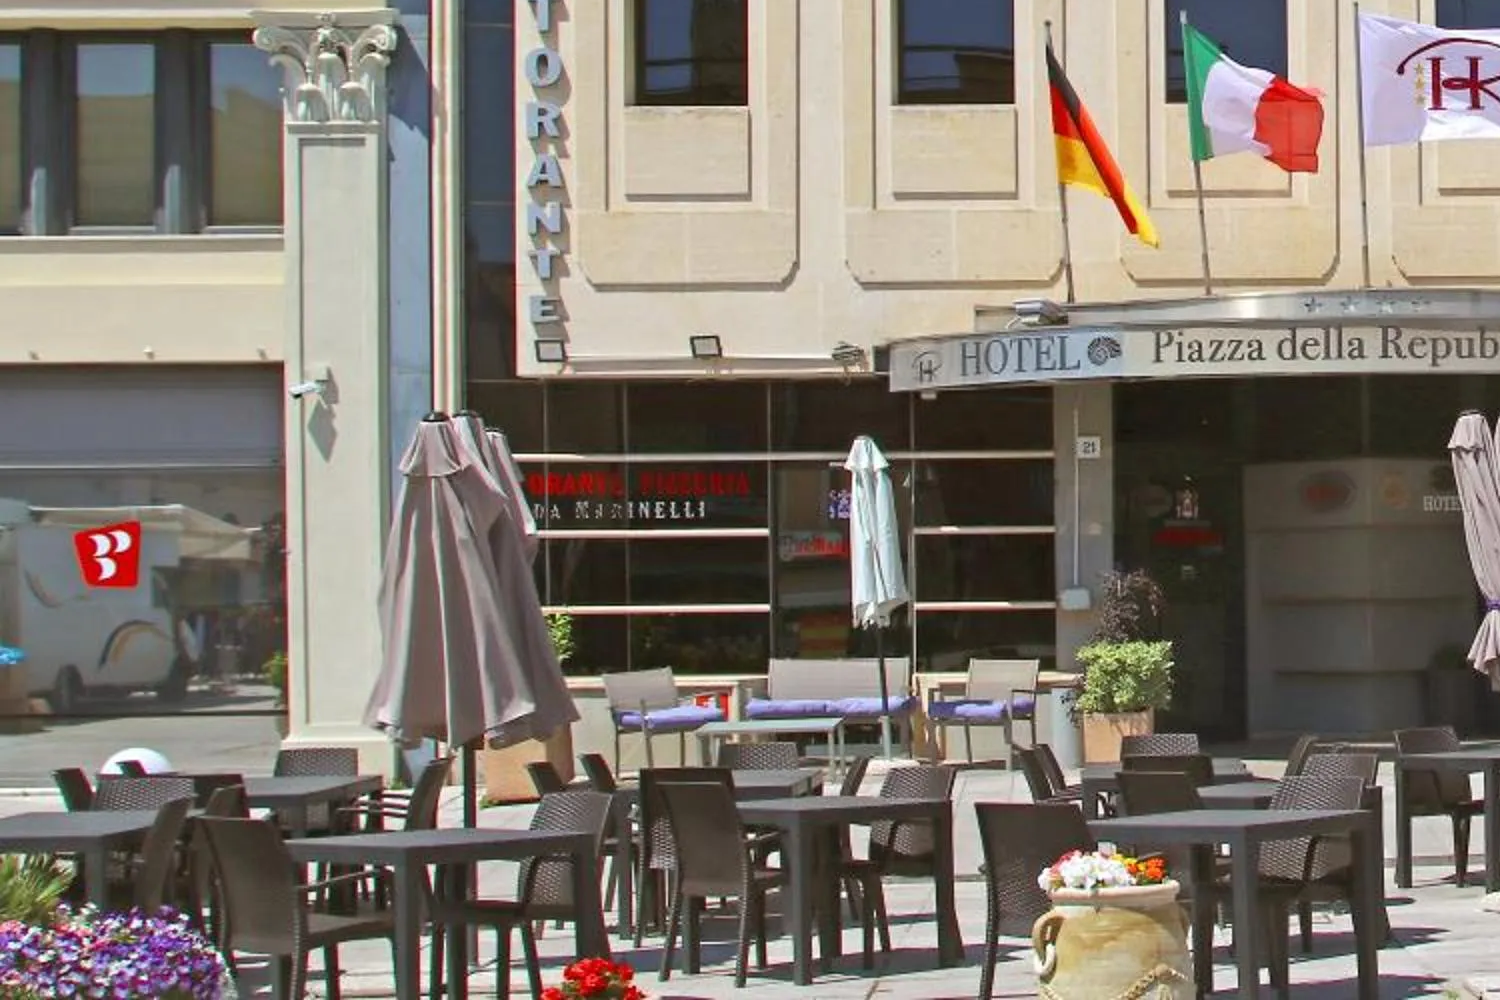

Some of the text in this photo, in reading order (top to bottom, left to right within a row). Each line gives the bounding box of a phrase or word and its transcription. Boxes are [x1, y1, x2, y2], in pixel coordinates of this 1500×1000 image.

[959, 335, 1081, 377] HOTEL
[1152, 329, 1268, 364] Piazza
[1278, 326, 1367, 362] della
[1423, 495, 1464, 512] HOTE
